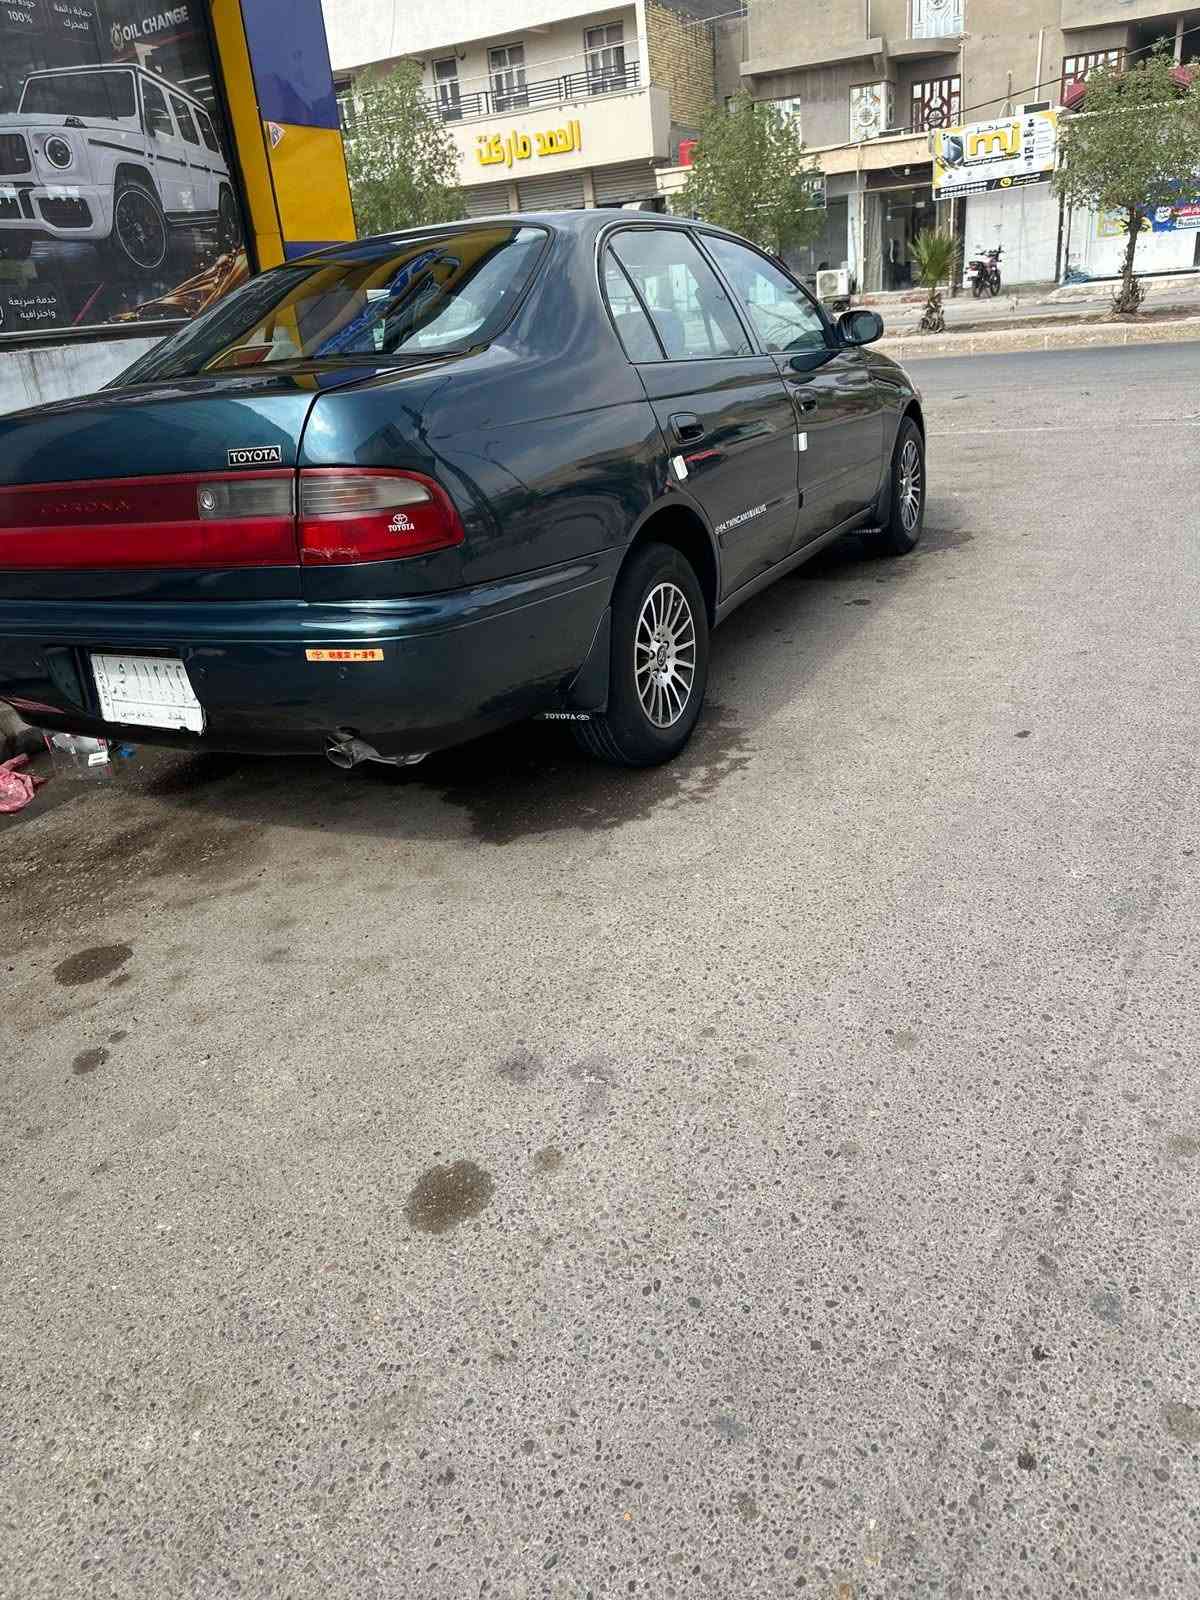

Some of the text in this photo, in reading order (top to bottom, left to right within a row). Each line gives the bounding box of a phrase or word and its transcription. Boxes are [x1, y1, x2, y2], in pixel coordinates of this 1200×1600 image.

[7, 10, 33, 24] 100%
[122, 5, 190, 41] OIL CHANGE
[476, 119, 582, 169] الحمد ماركت
[8, 295, 57, 307] خدمة سريعة
[20, 309, 56, 320] واحترافية
[229, 448, 279, 463] TOYOTA
[387, 522, 415, 533] TOYOTA
[543, 712, 576, 721] TOYOTA
